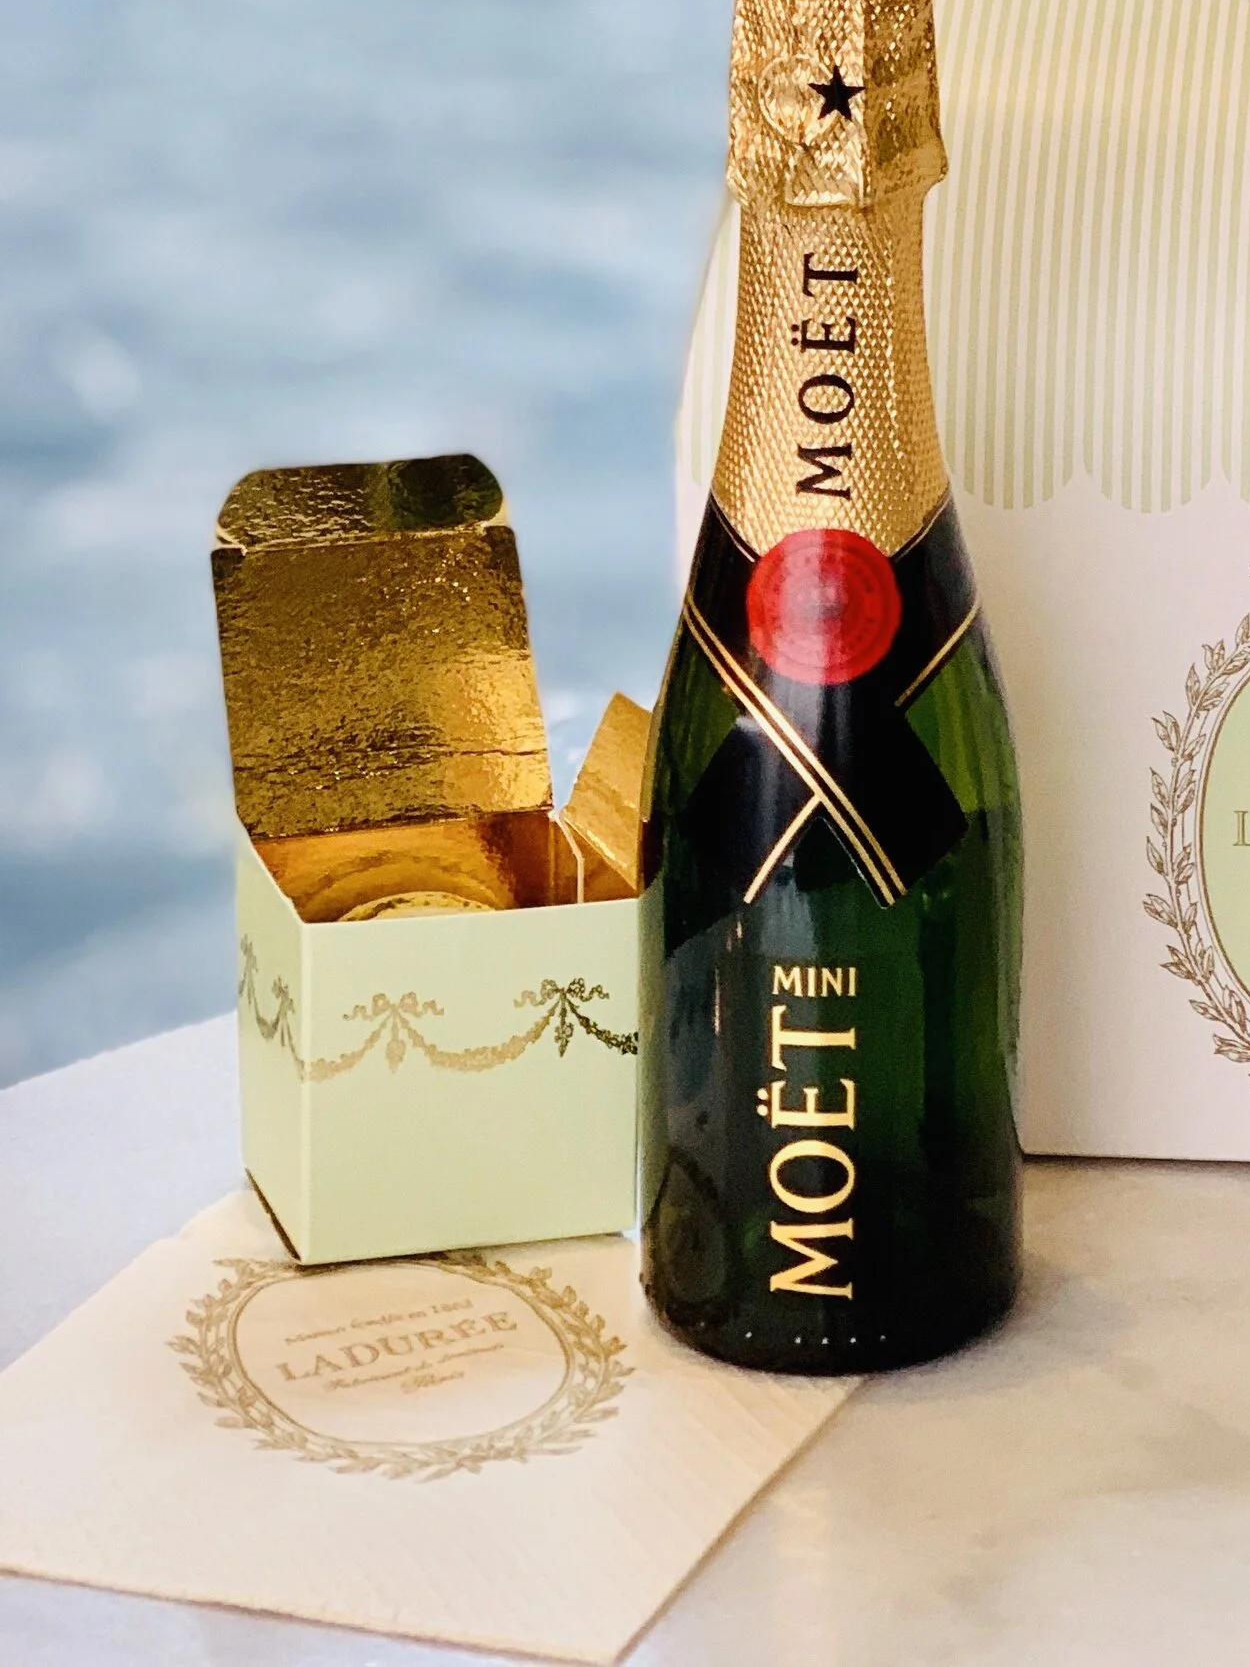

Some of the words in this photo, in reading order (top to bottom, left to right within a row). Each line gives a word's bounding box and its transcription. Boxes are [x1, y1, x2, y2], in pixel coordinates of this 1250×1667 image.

[790, 252, 859, 501] MOËT
[771, 965, 858, 998] MINI
[756, 1004, 857, 1301] MOËT
